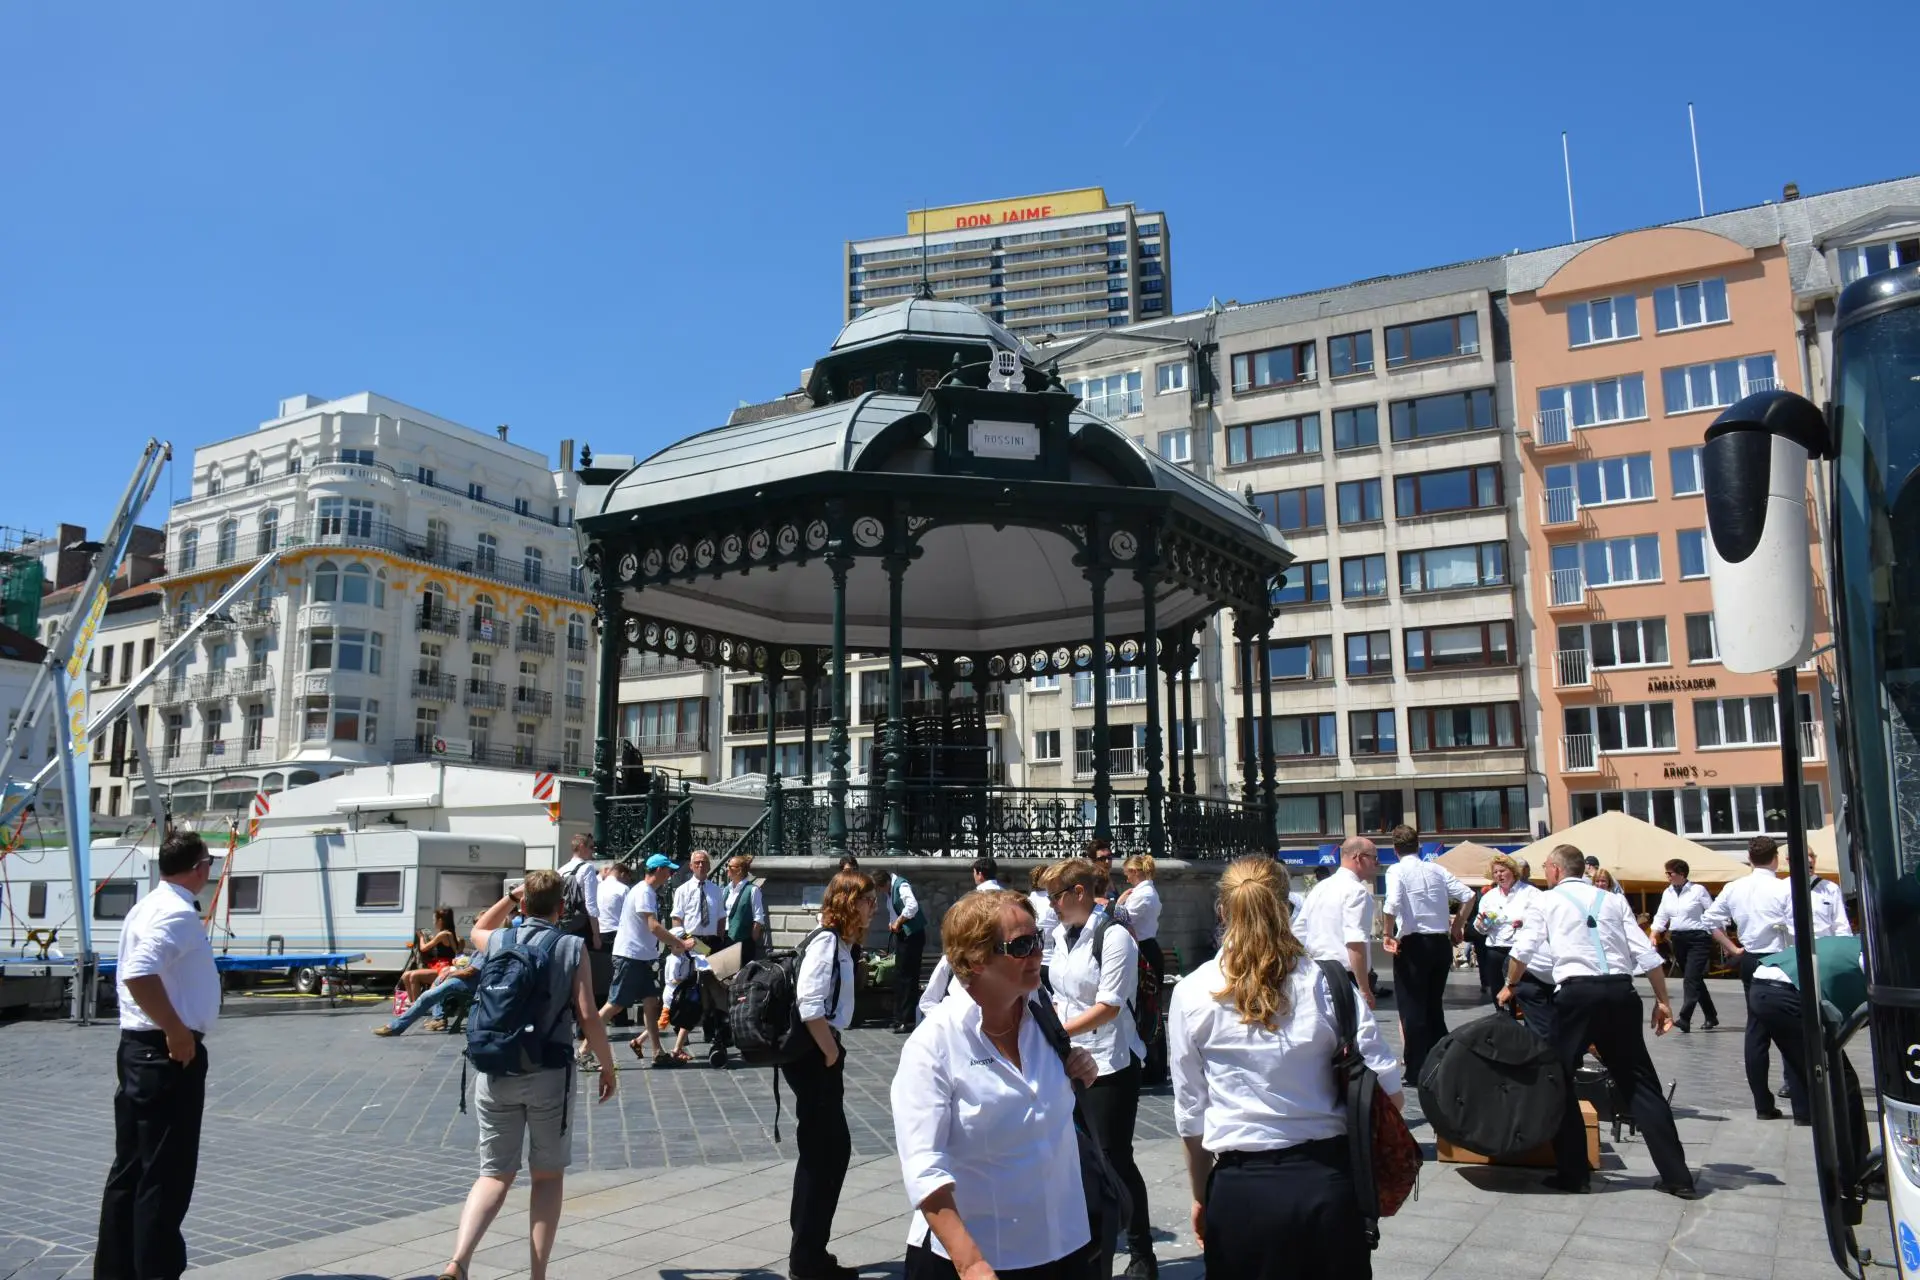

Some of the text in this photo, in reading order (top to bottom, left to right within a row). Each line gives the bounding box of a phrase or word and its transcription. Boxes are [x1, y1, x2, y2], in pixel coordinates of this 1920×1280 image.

[956, 206, 1052, 228] DON JAIME
[984, 434, 1024, 446] ROSSINI
[1647, 678, 1717, 693] AMBASSADEUR
[1663, 765, 1698, 779] ARNO'S
[1319, 855, 1337, 864] AXA
